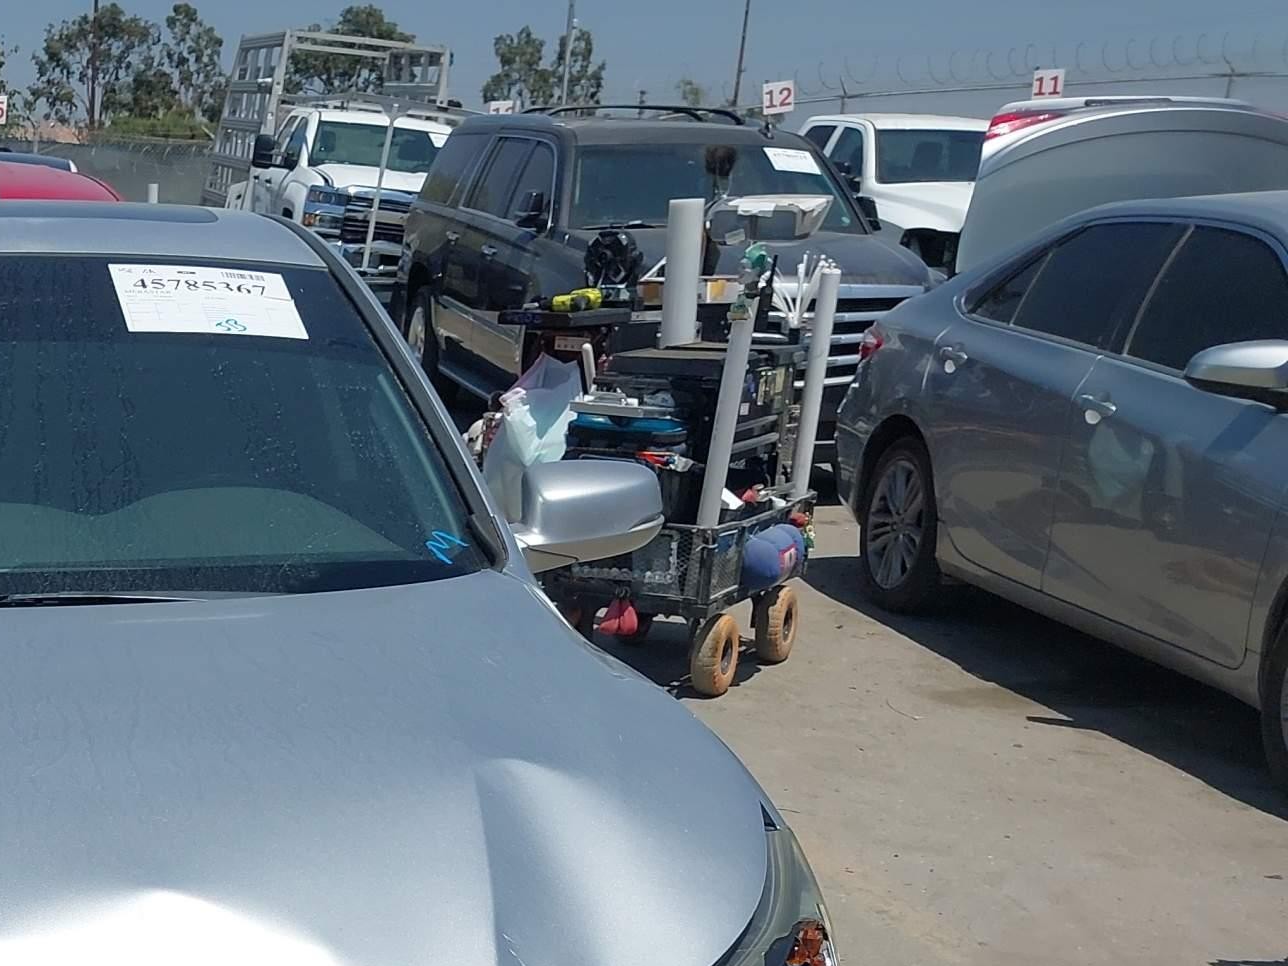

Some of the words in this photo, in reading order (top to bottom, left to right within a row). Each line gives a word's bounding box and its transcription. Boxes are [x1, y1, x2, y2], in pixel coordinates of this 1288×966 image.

[1033, 75, 1061, 97] 11
[765, 87, 792, 109] 12
[133, 278, 265, 296] 45785367
